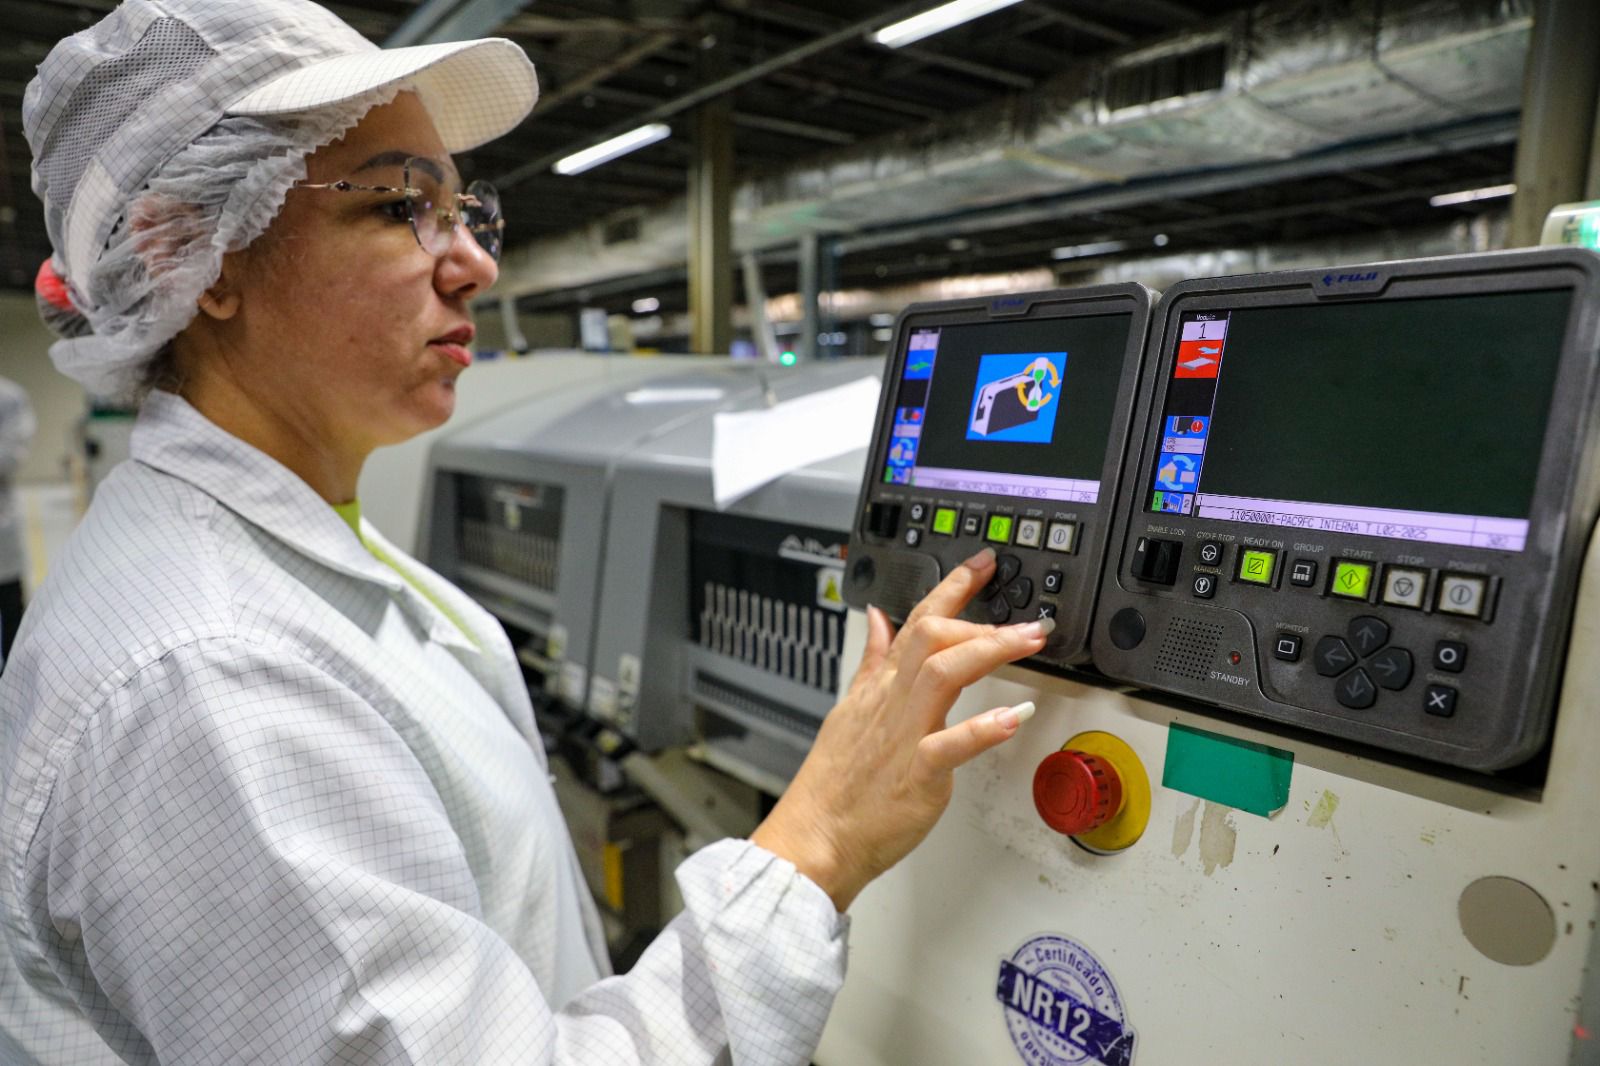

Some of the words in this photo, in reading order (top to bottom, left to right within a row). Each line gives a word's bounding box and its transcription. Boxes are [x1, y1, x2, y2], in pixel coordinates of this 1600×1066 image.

[1337, 271, 1377, 283] FUJI
[1198, 322, 1207, 339] 1
[1027, 508, 1043, 516] STOP
[1054, 511, 1077, 521] POWER
[1319, 519, 1360, 534] INTERNA
[1243, 536, 1268, 548] READY
[1271, 540, 1284, 549] ON
[1293, 542, 1324, 553] GROUP
[1341, 548, 1373, 560] START
[1397, 555, 1424, 565] STOP
[1275, 621, 1310, 634] MONITOR
[1209, 670, 1251, 687] STANDBY
[1034, 946, 1105, 996] Certificado
[1011, 972, 1092, 1047] NR12
